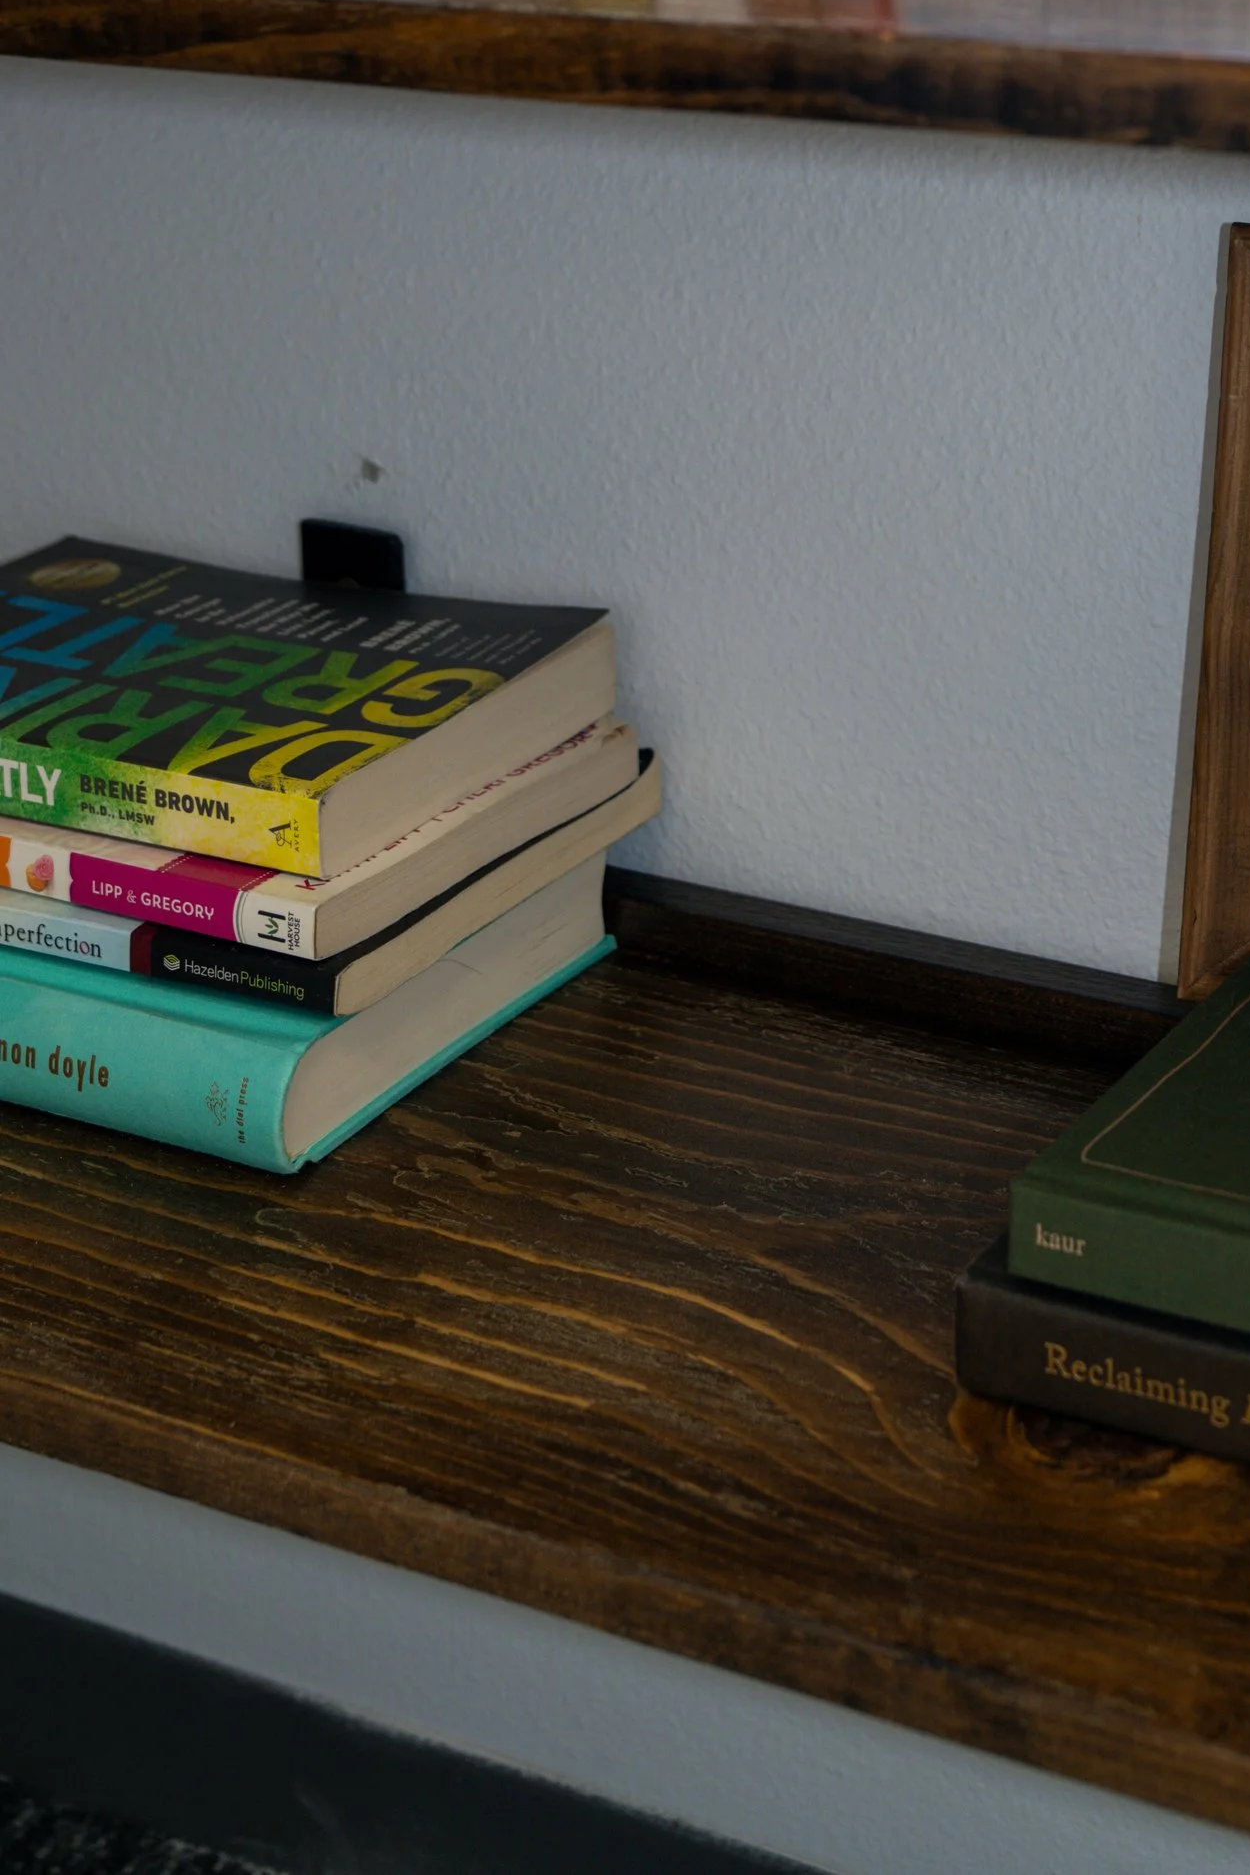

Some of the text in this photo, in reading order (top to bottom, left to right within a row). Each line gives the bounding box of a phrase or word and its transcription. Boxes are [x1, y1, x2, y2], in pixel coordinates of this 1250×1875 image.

[0, 589, 507, 728] GREATL
[79, 773, 148, 805] BRENÉ
[154, 791, 236, 824] BROWN,
[118, 810, 156, 826] LMSW
[293, 818, 301, 852] AVERY
[92, 880, 215, 921] LIPP & GREGORY
[293, 917, 301, 948] HOUSE
[48, 1045, 110, 1092] doyle
[236, 1076, 249, 1144] the dial press
[1035, 1222, 1086, 1256] kaur
[1044, 1342, 1231, 1427] Reclaiming
